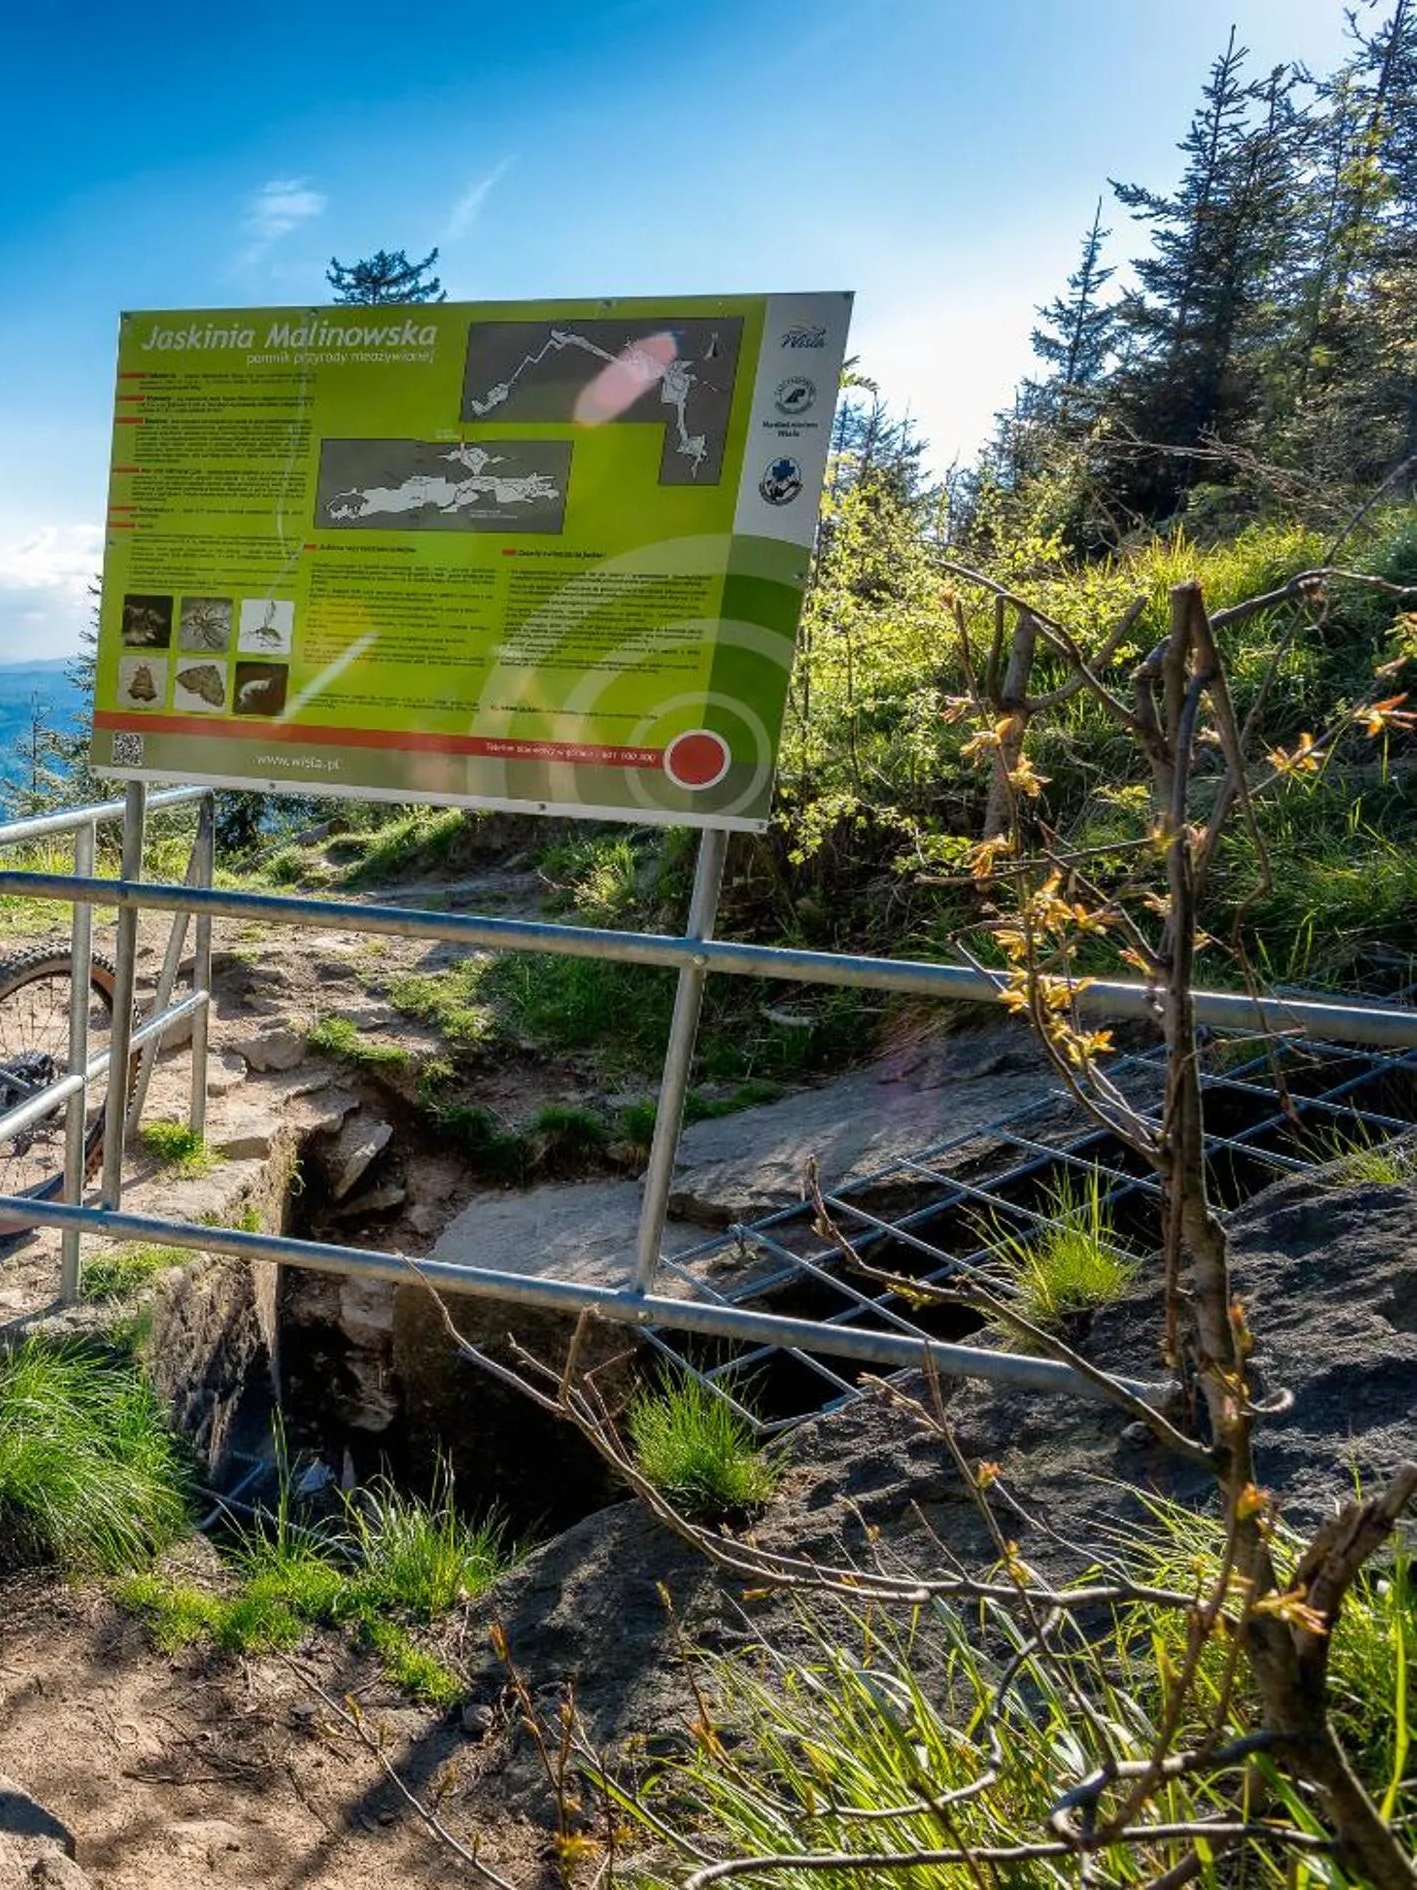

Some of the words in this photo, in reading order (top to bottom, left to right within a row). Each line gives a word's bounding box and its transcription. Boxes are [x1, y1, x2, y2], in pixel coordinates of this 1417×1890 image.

[141, 324, 256, 351] Jaskinia
[264, 319, 438, 349] Malinowska
[246, 350, 290, 366] pomnik
[293, 350, 348, 366] przyrody
